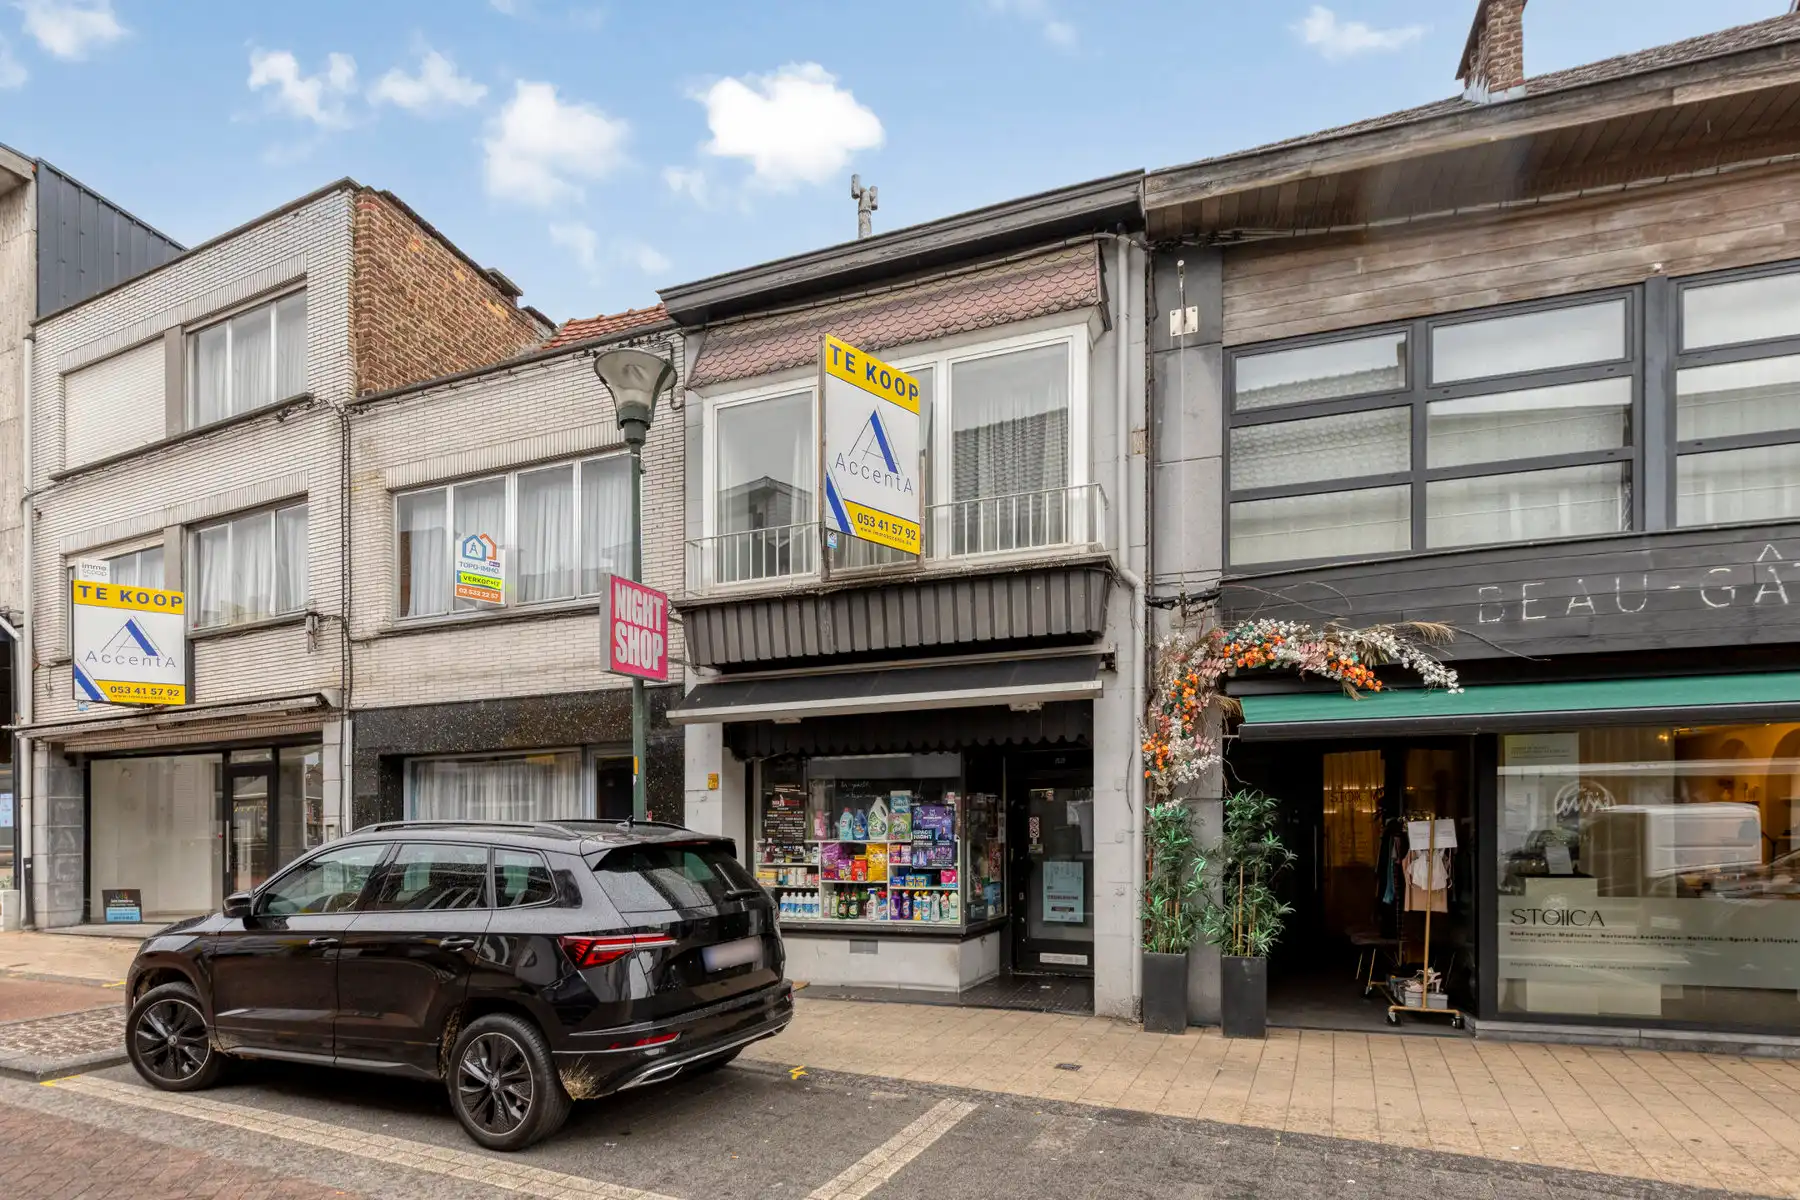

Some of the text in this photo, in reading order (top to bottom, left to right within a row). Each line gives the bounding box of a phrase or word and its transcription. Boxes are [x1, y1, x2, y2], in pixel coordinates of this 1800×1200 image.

[829, 343, 919, 401] TE KOOP
[835, 452, 914, 495] AccentA
[857, 512, 916, 540] 053 41 57 92
[459, 561, 499, 573] TOPO-IMMO
[1478, 544, 1800, 624] BEAU-GÂ
[78, 585, 183, 607] TE KOOP
[614, 581, 664, 631] NIGHT
[85, 650, 176, 668] AccentA
[614, 621, 664, 671] SHOP
[110, 685, 180, 697] 053 41 57 92
